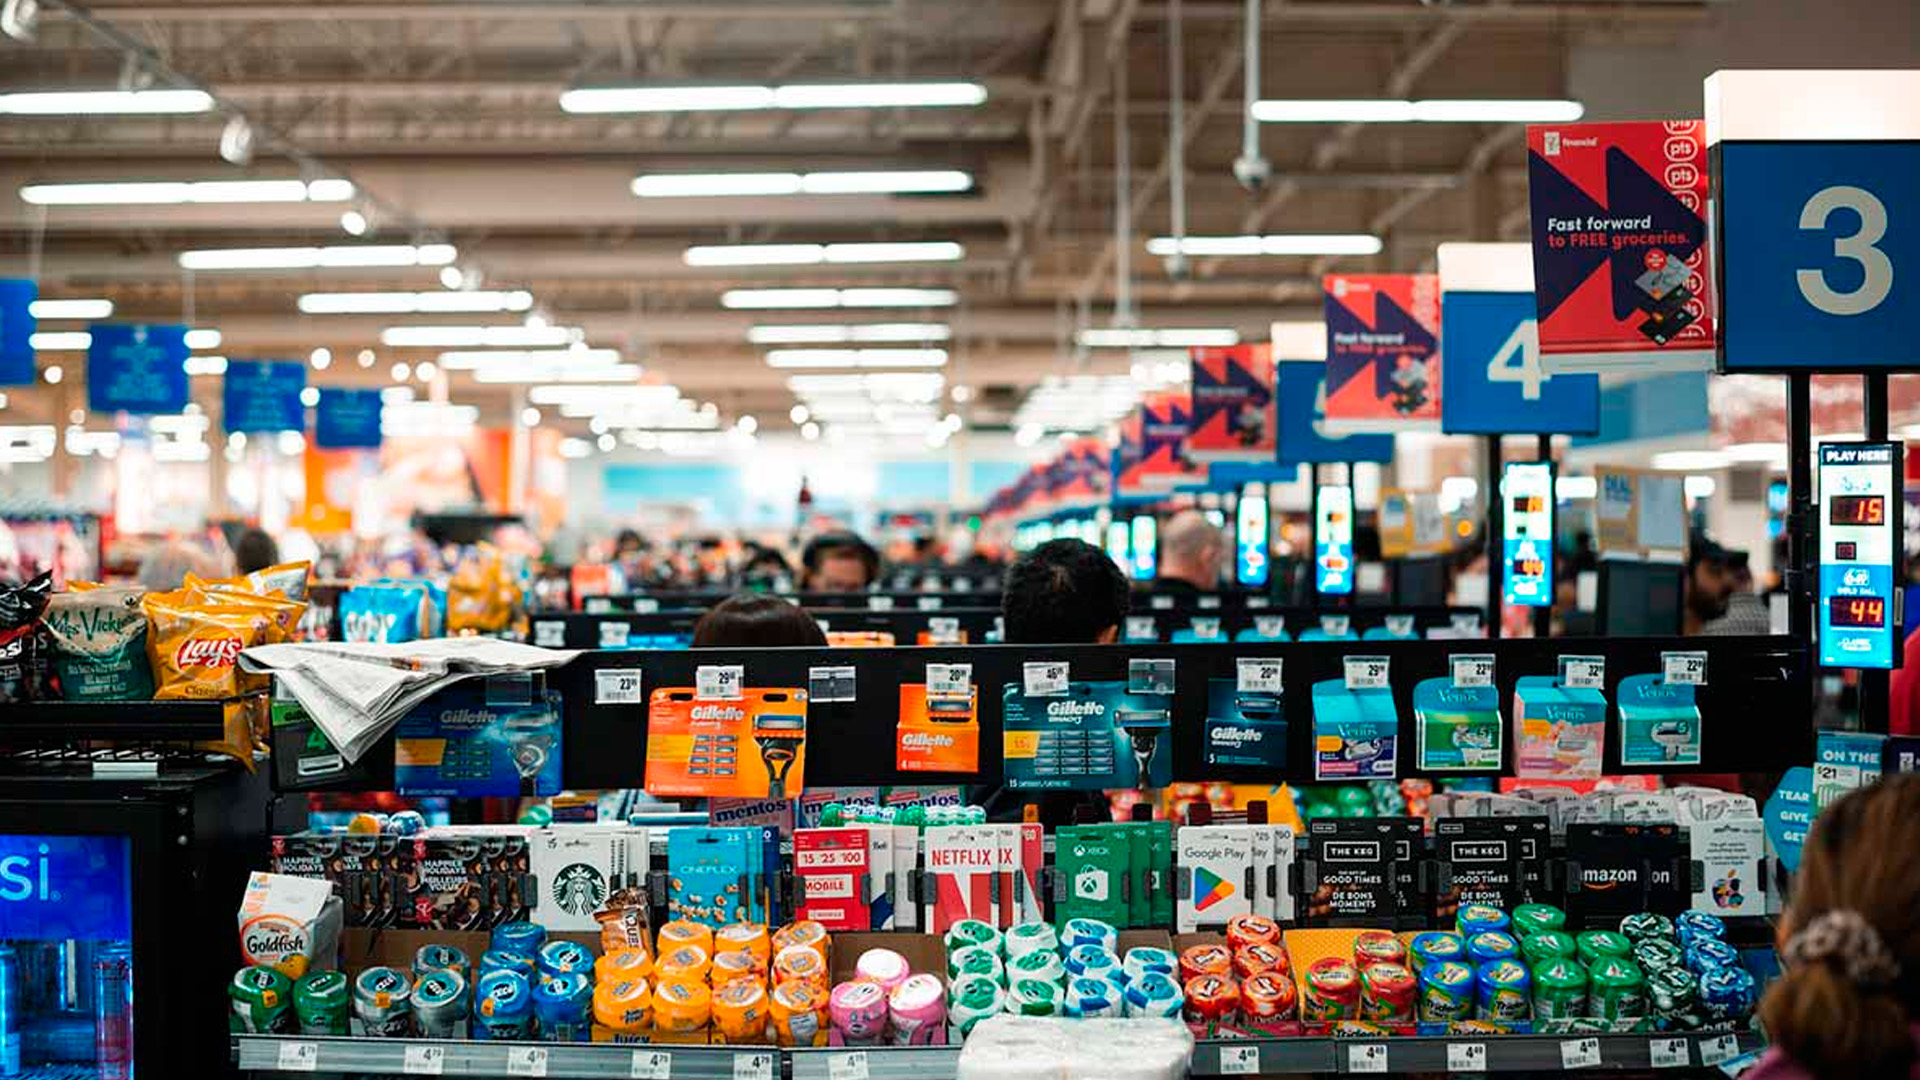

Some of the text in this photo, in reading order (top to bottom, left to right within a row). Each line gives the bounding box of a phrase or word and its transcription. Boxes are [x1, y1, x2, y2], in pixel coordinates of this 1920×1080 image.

[1670, 145, 1692, 157] pts
[1670, 172, 1693, 185] pts
[1547, 215, 1652, 232] Fast forward
[1549, 232, 1690, 249] to FREE groceries.
[1796, 185, 1894, 316] 3
[1487, 319, 1551, 401] 4
[1826, 450, 1888, 462] PLAY HERE
[1857, 499, 1882, 524] 15
[1851, 600, 1883, 622] 44
[179, 637, 241, 669] Lay's
[690, 704, 745, 723] Gillette
[1046, 701, 1105, 717] Gillette
[440, 707, 498, 726] Gillette
[901, 733, 954, 748] Gillette
[1210, 727, 1263, 742] Gillette
[1822, 750, 1880, 764] ON THE
[1779, 790, 1810, 801] TEAR
[715, 800, 787, 823] mentos
[1780, 811, 1809, 823] GIVE
[1783, 831, 1808, 842] GET
[820, 853, 835, 863] 25
[842, 851, 861, 863] 100
[932, 849, 991, 866] NETFLIX
[1185, 848, 1245, 860] Google Play
[1330, 847, 1374, 856] THE KEG
[1457, 847, 1501, 856] THE KEG
[0, 843, 50, 901] si
[282, 864, 325, 873] HOLIDAYS
[423, 866, 467, 876] HOLIDAYS
[680, 865, 738, 874] CINEPLEX
[1323, 875, 1382, 884] GOOD TIMES
[1453, 874, 1510, 884] GOOD TIMES
[1583, 869, 1637, 882] mazon
[805, 881, 845, 891] MOBILE
[1332, 891, 1374, 900] DE BONS
[1461, 891, 1502, 900] DE BONS
[1329, 900, 1378, 909] MOMENTS
[246, 933, 305, 955] Goldfish
